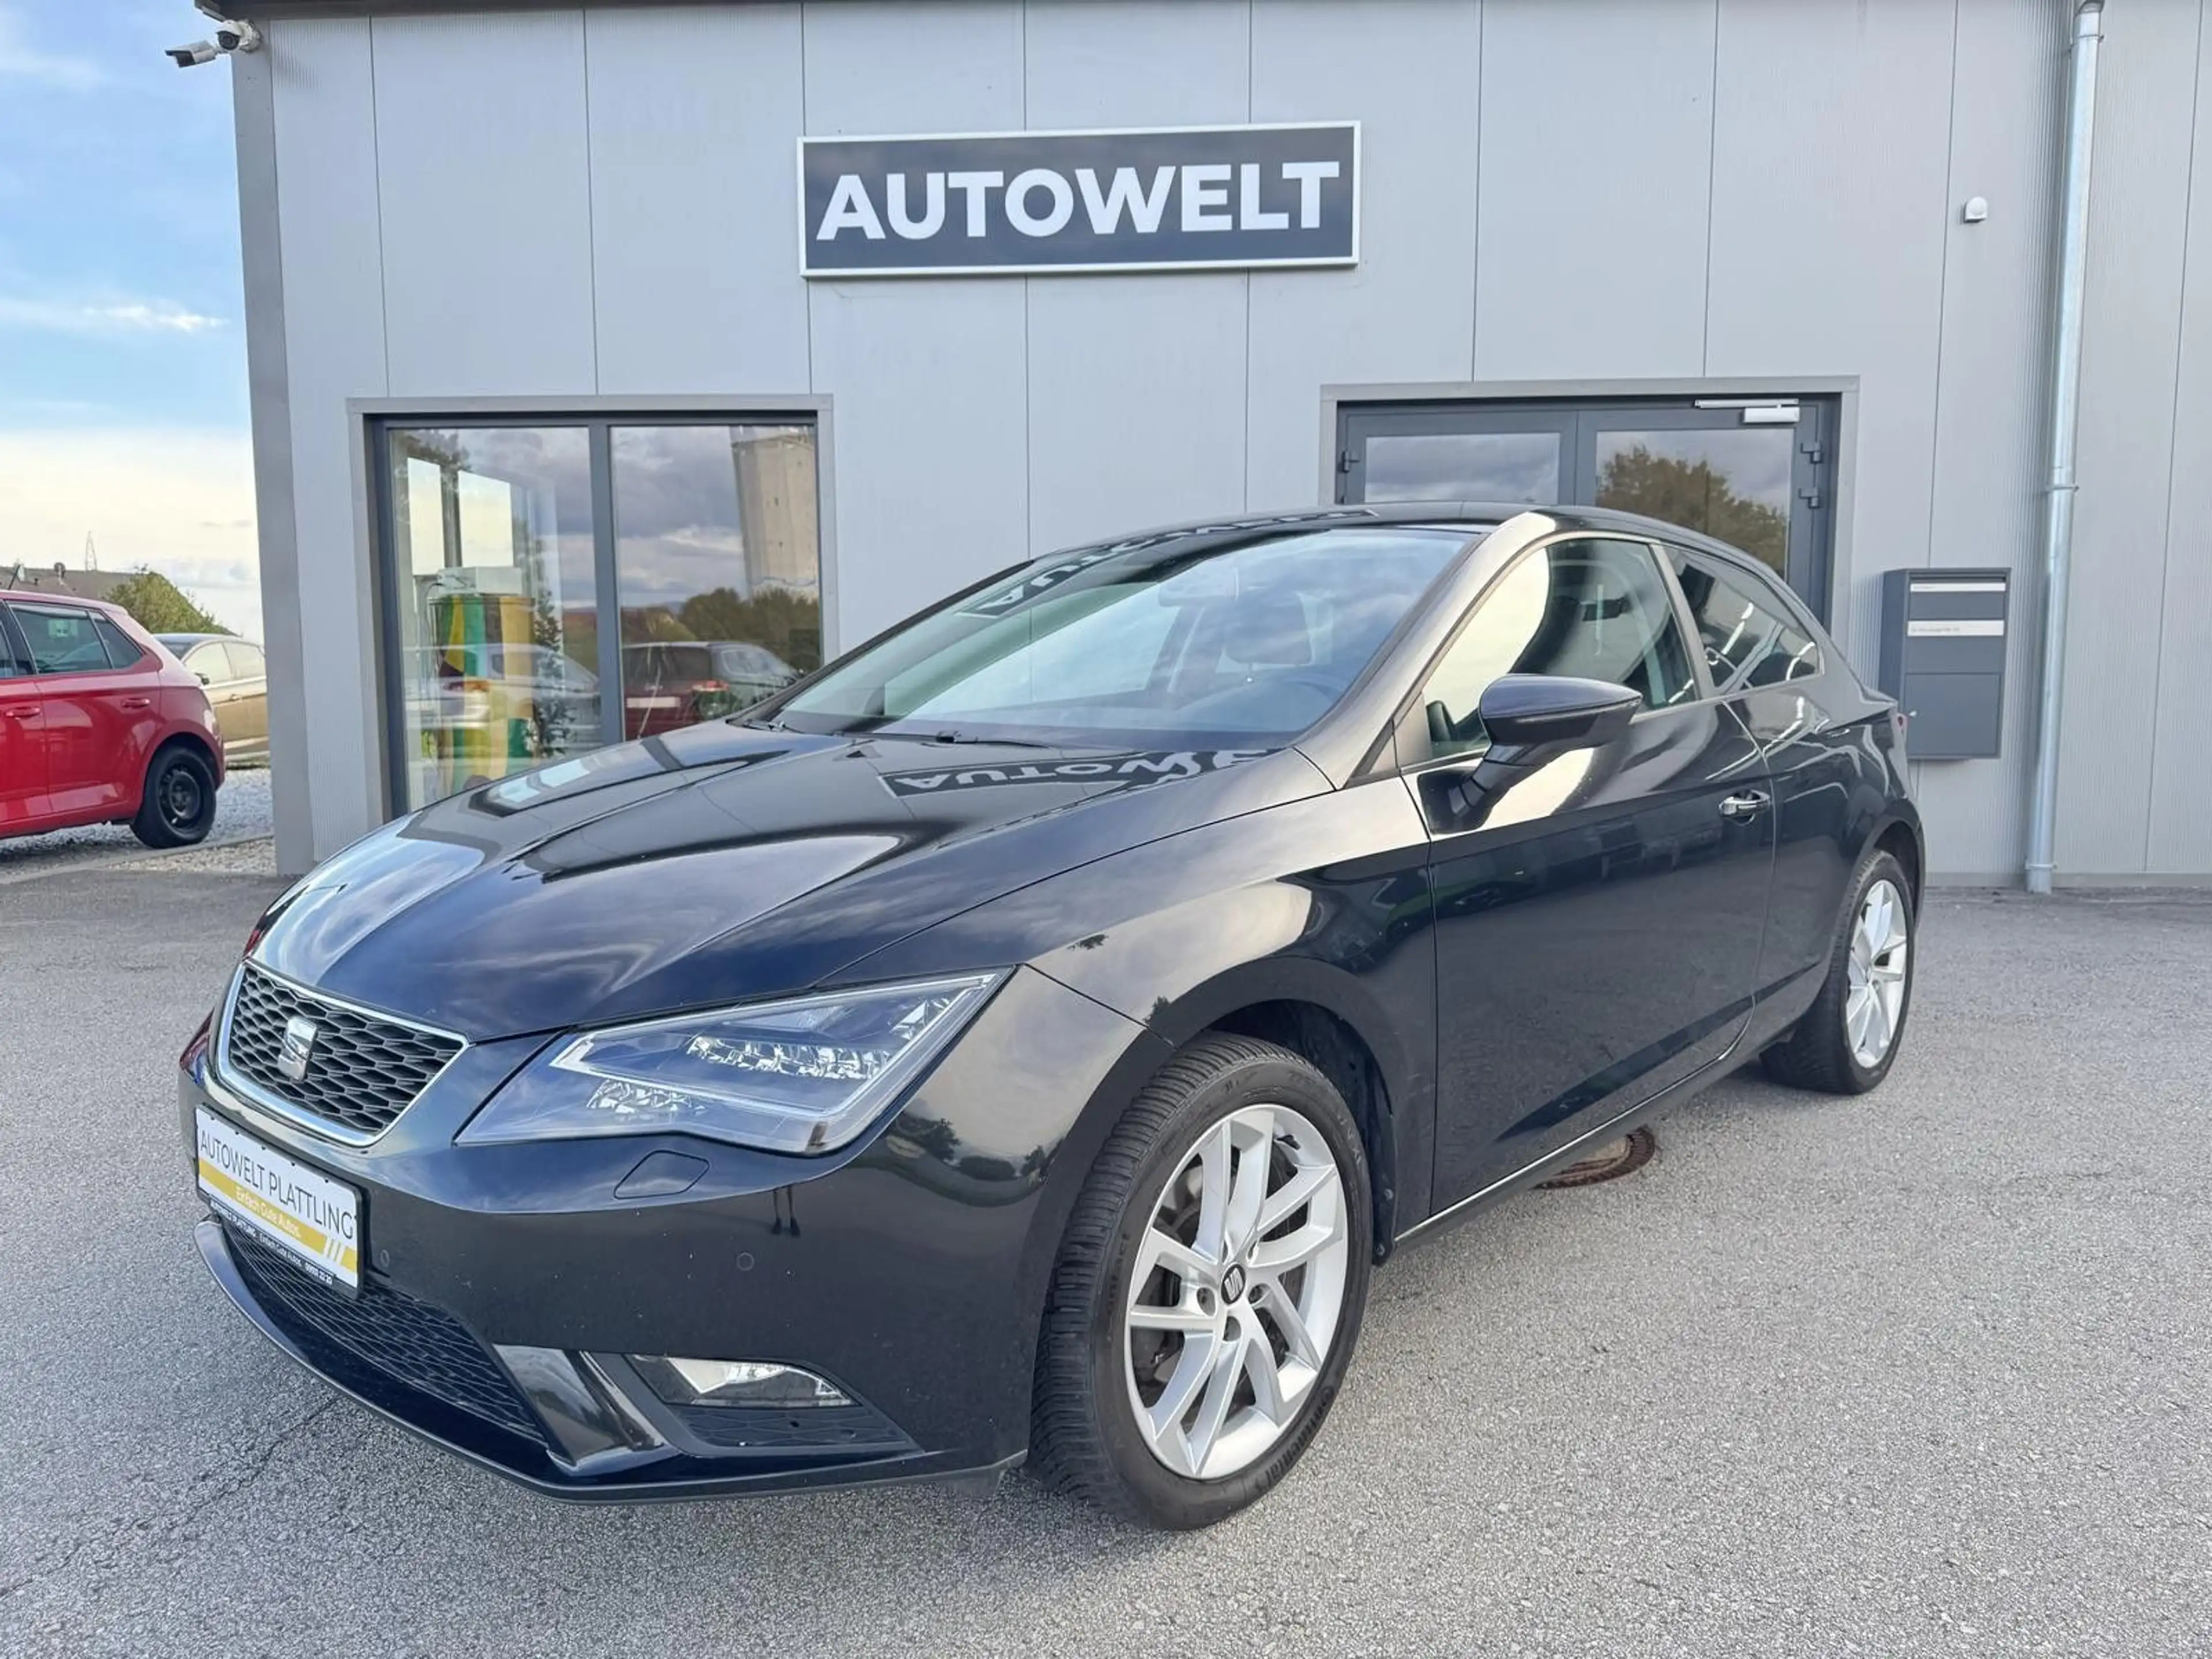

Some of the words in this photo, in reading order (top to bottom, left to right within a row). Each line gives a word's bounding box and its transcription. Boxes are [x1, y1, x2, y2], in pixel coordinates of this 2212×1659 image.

[816, 161, 1339, 241] AUTOWELT
[200, 1131, 264, 1190] AUTOWELT
[269, 1172, 354, 1240] PLATTLING
